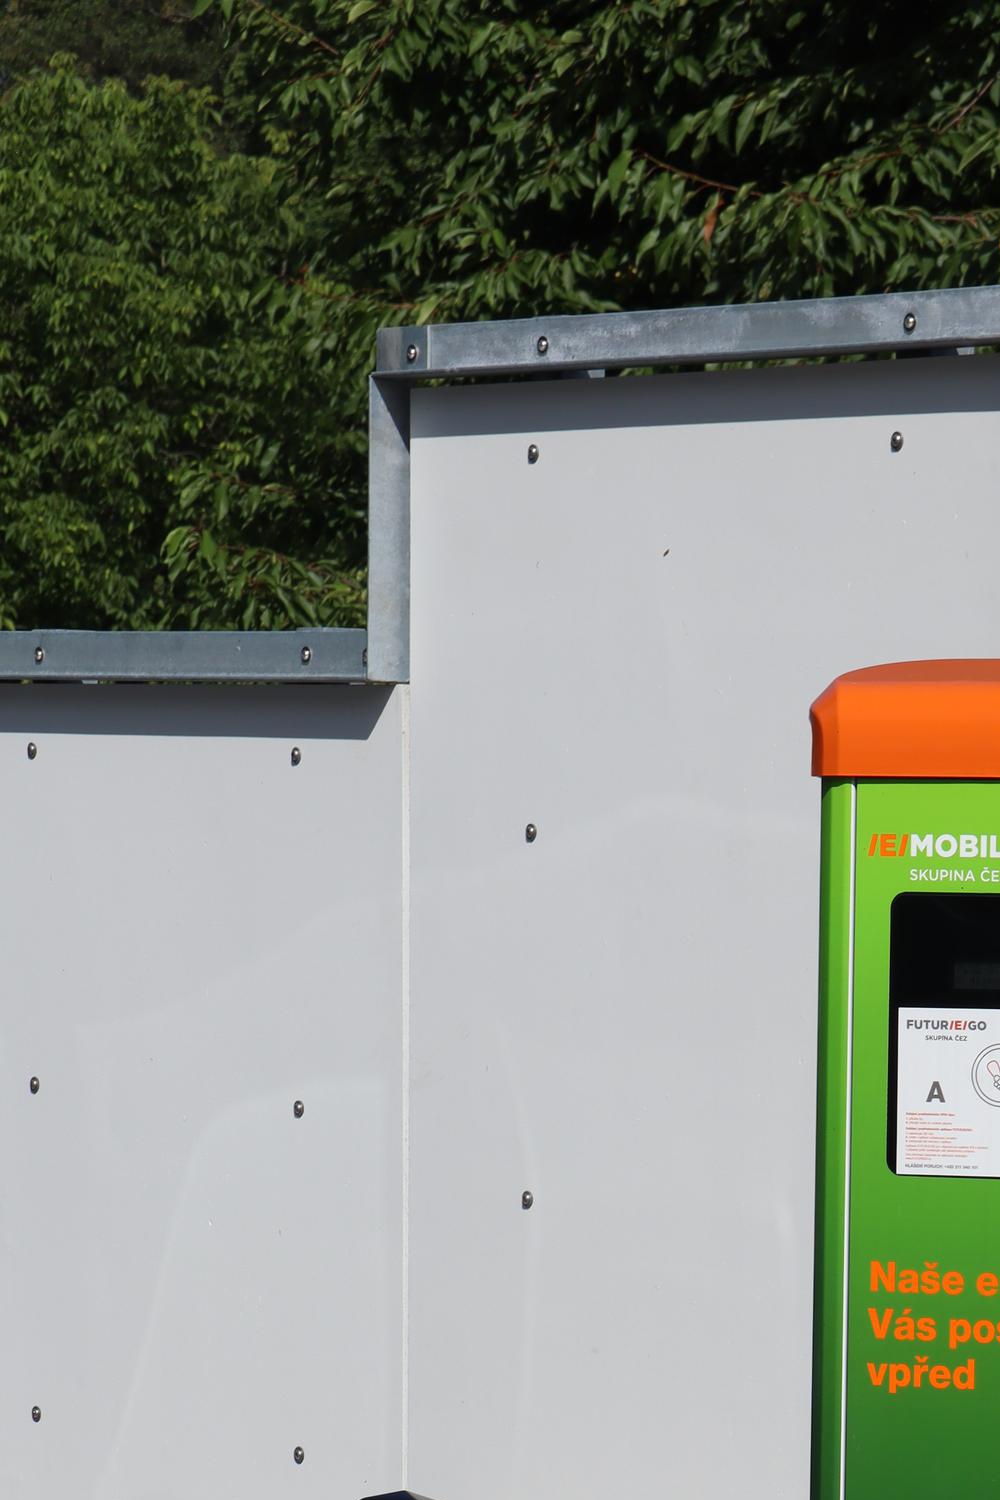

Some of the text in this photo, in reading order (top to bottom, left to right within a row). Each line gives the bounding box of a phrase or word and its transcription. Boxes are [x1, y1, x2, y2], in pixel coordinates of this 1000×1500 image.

[909, 869, 976, 882] SKUPINA
[925, 1080, 946, 1103] A
[869, 1260, 964, 1296] Naše
[868, 1308, 937, 1342] Vás
[867, 1356, 976, 1393] vpřed
